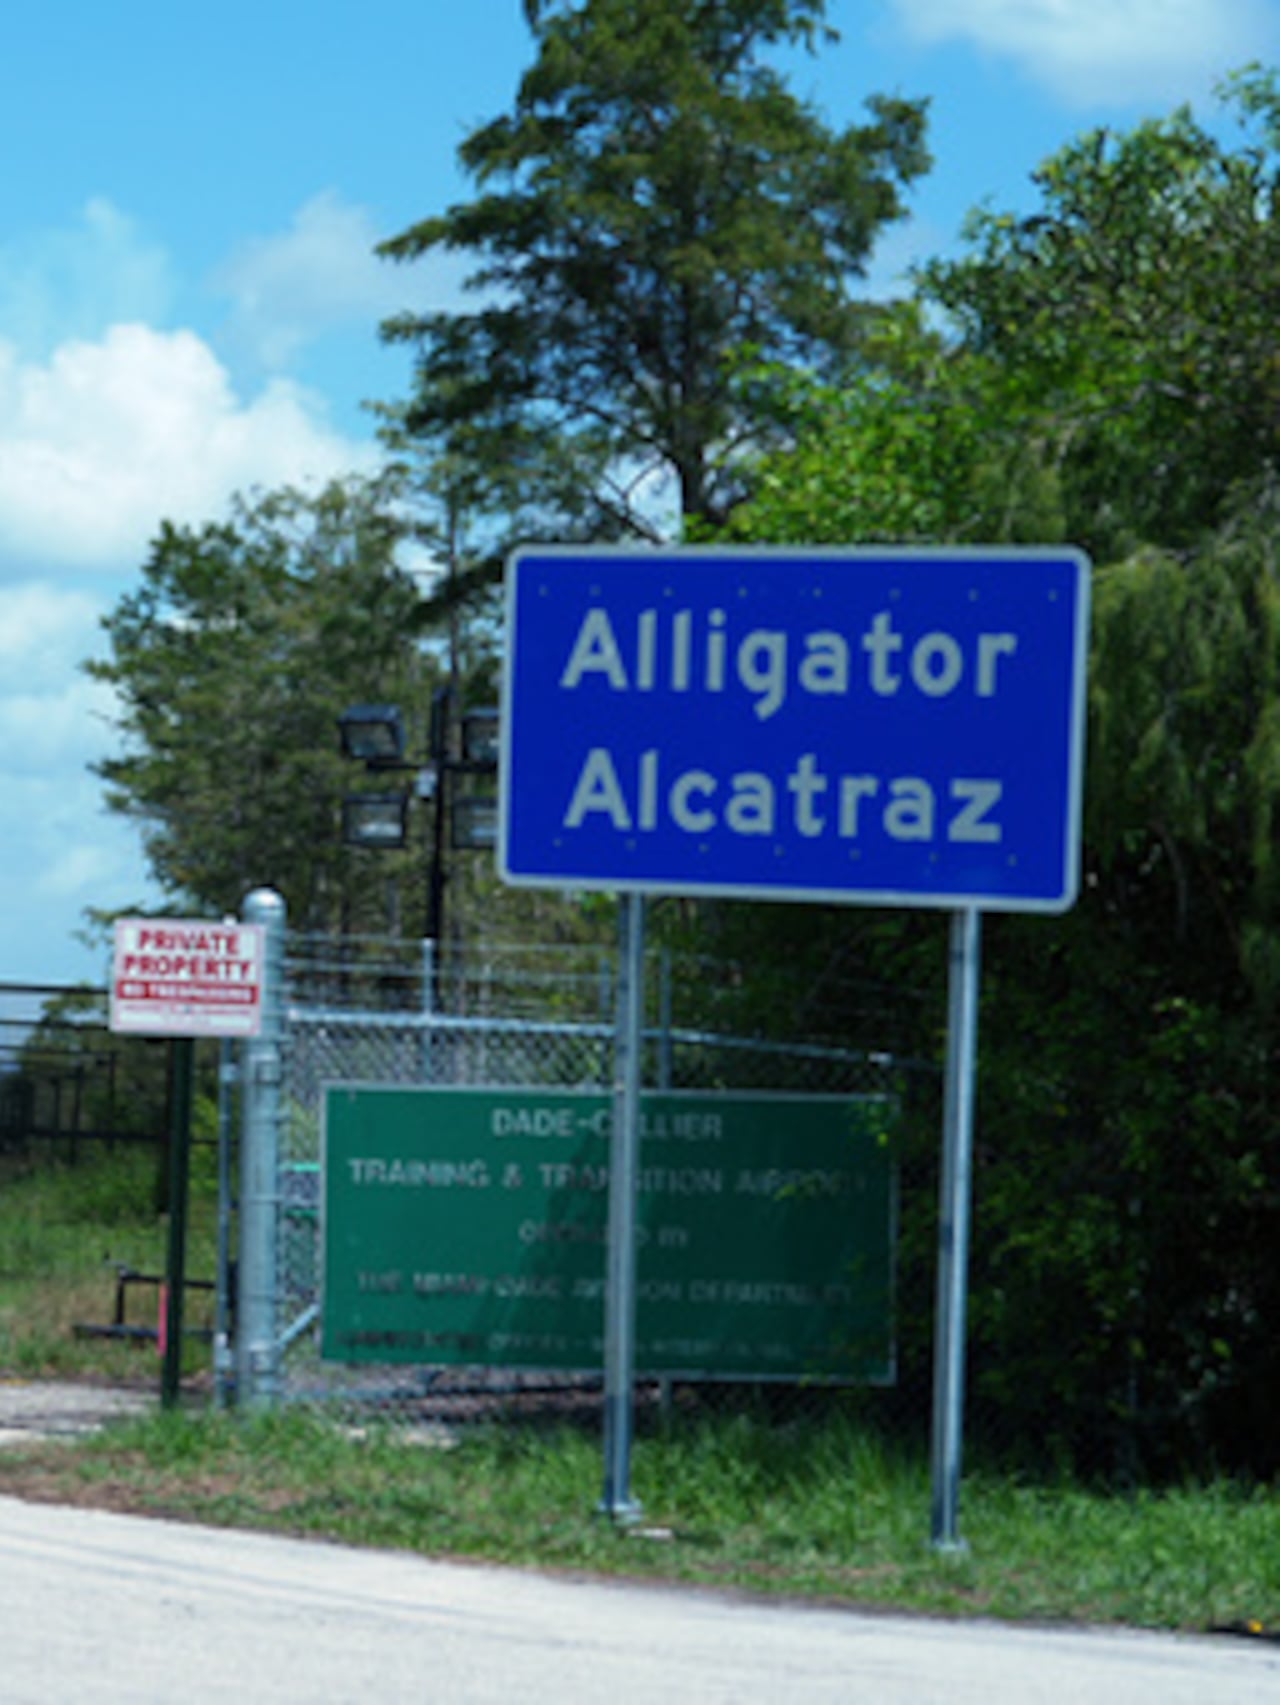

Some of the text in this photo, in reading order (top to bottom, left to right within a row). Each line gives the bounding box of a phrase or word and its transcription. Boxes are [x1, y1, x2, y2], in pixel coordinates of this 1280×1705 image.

[560, 608, 1017, 721] Alligator
[562, 747, 1003, 843] Alcatraz
[138, 929, 239, 954] PRIVATE
[123, 954, 251, 979] PROPERTY
[491, 1107, 723, 1140] DADE-CLLIER
[348, 1158, 489, 1188] TRAINING
